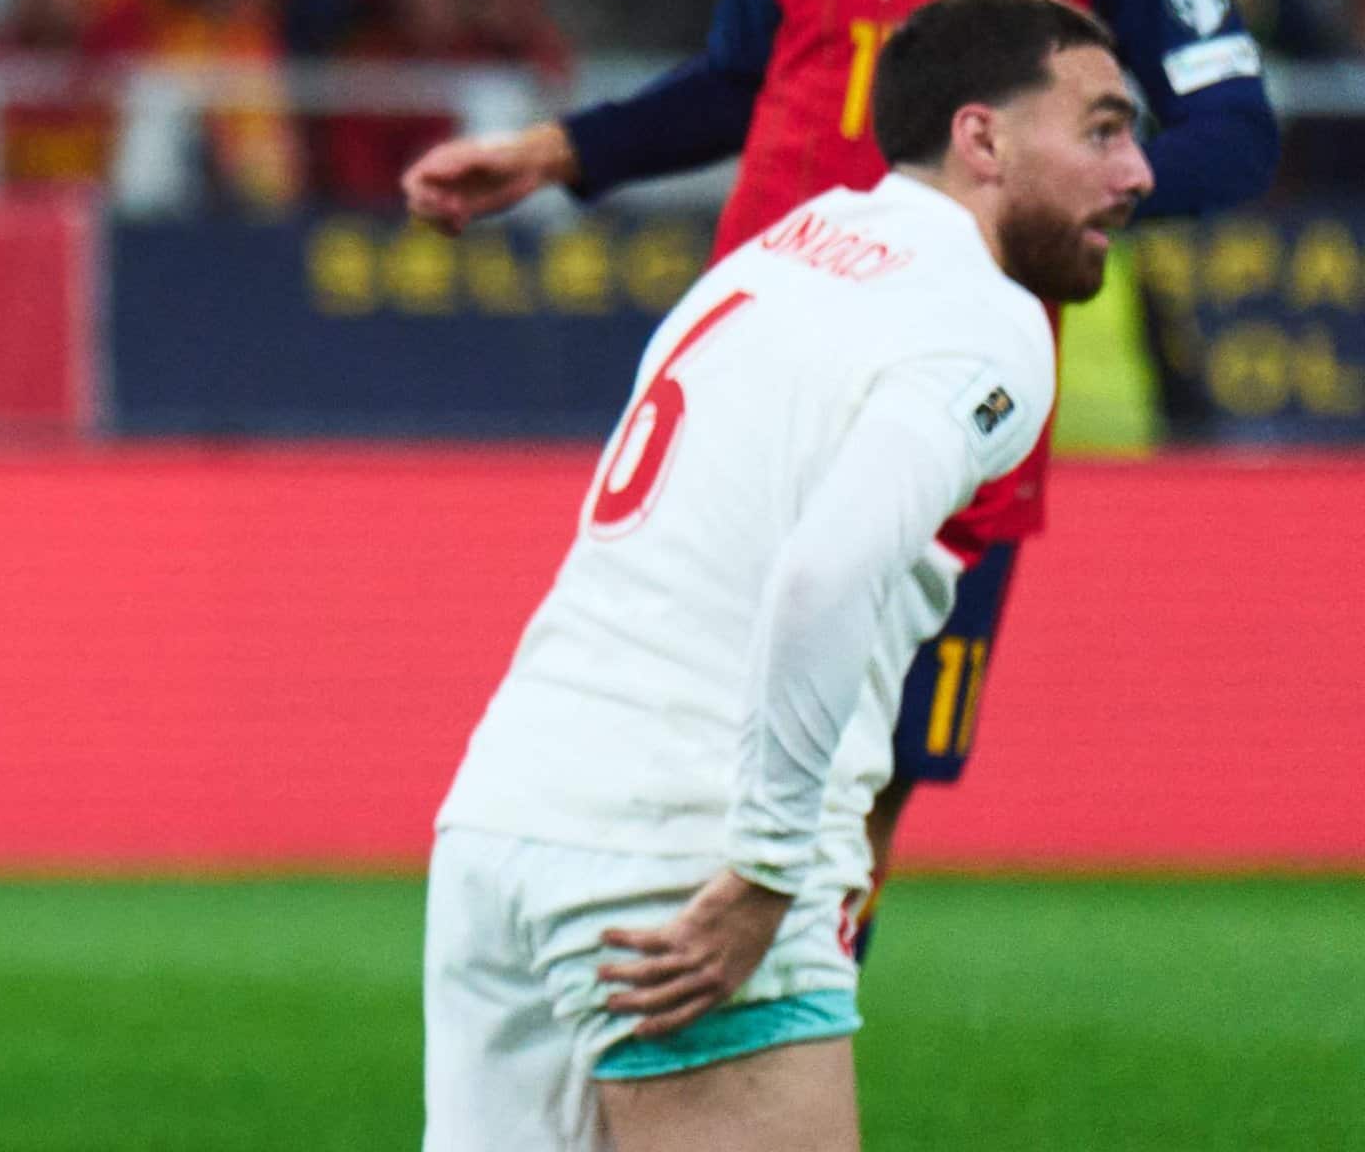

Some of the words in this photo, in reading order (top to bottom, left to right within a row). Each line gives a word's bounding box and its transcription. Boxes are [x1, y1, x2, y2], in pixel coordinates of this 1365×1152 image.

[840, 18, 895, 141] 1
[590, 288, 756, 536] 6
[926, 636, 986, 758] 11
